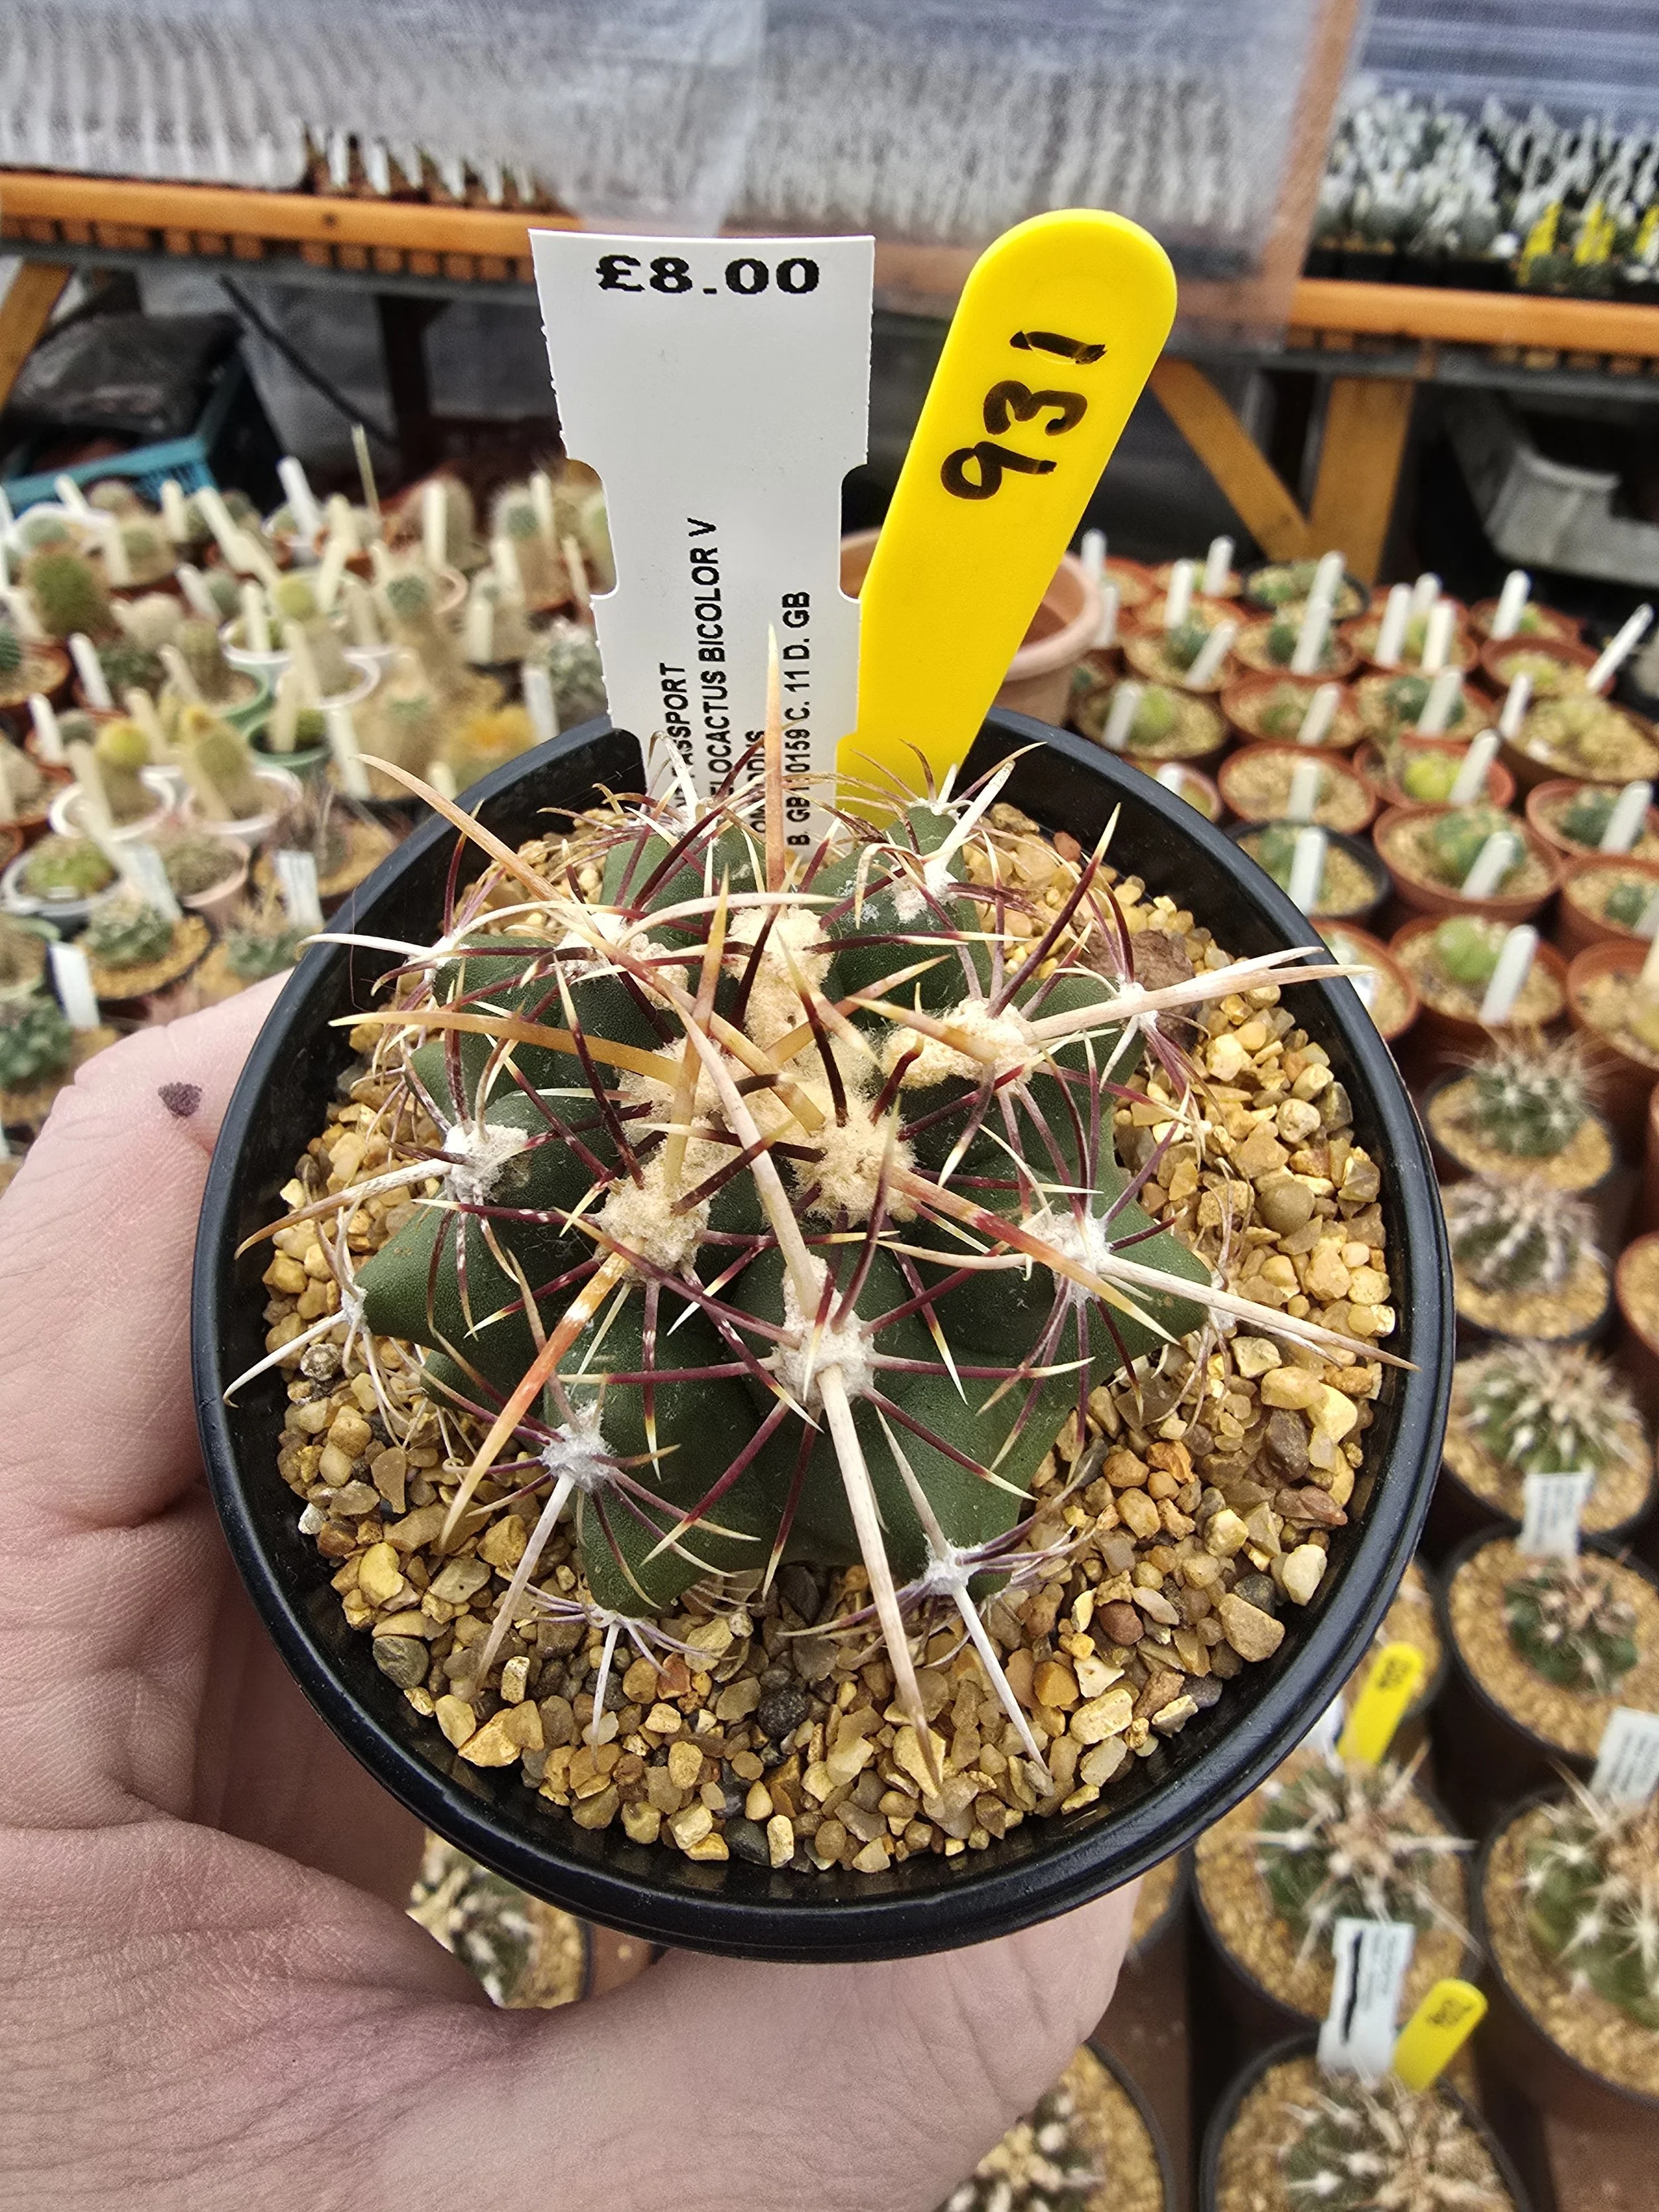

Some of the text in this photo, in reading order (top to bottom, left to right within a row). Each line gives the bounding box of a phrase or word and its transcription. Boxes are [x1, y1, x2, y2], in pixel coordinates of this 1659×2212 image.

[596, 254, 820, 295] £8.00
[940, 331, 1108, 500] 931
[687, 518, 717, 537] V
[690, 548, 726, 662] BICOLOR
[782, 592, 810, 628] GB
[784, 638, 810, 660] D.
[784, 670, 810, 692] 11
[784, 701, 810, 721] C.
